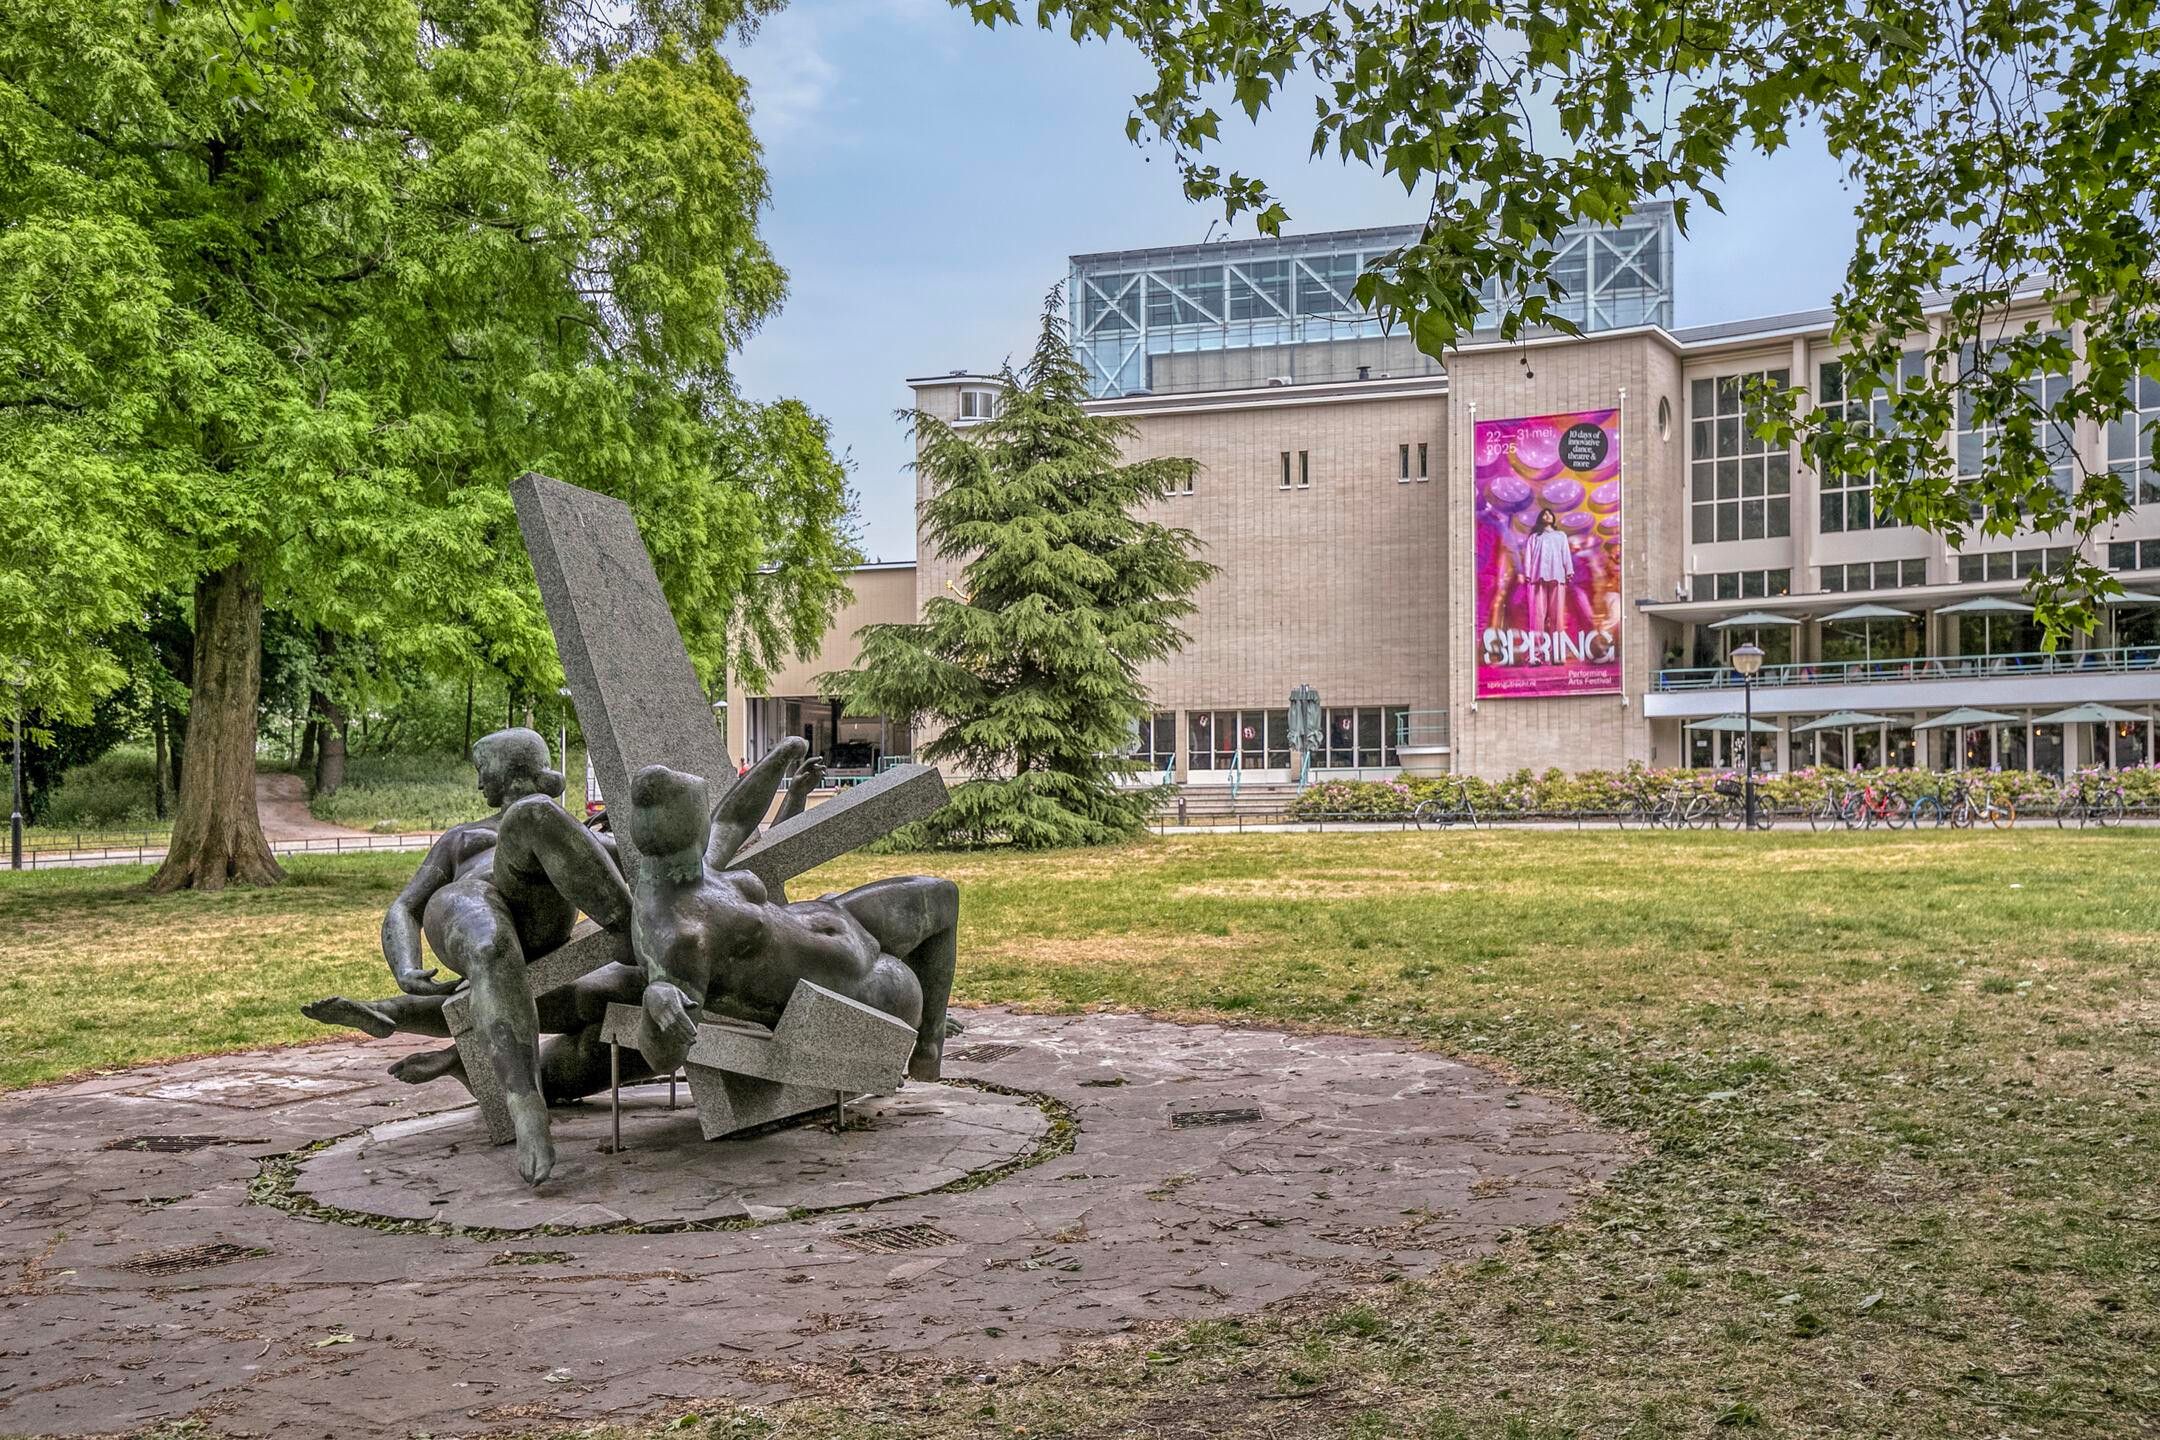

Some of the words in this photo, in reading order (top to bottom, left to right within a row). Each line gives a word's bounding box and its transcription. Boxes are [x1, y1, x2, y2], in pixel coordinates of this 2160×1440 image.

[1569, 430, 1577, 438] 10
[1578, 430, 1592, 440] days
[1592, 430, 1601, 439] of
[1568, 438, 1600, 447] innovative
[1486, 443, 1517, 455] 2025
[1567, 451, 1590, 460] theatre
[1590, 452, 1597, 461] &
[1572, 460, 1590, 468] more
[1483, 628, 1615, 665] SPRING
[1568, 670, 1608, 679] Performing
[1584, 676, 1612, 685] Festival
